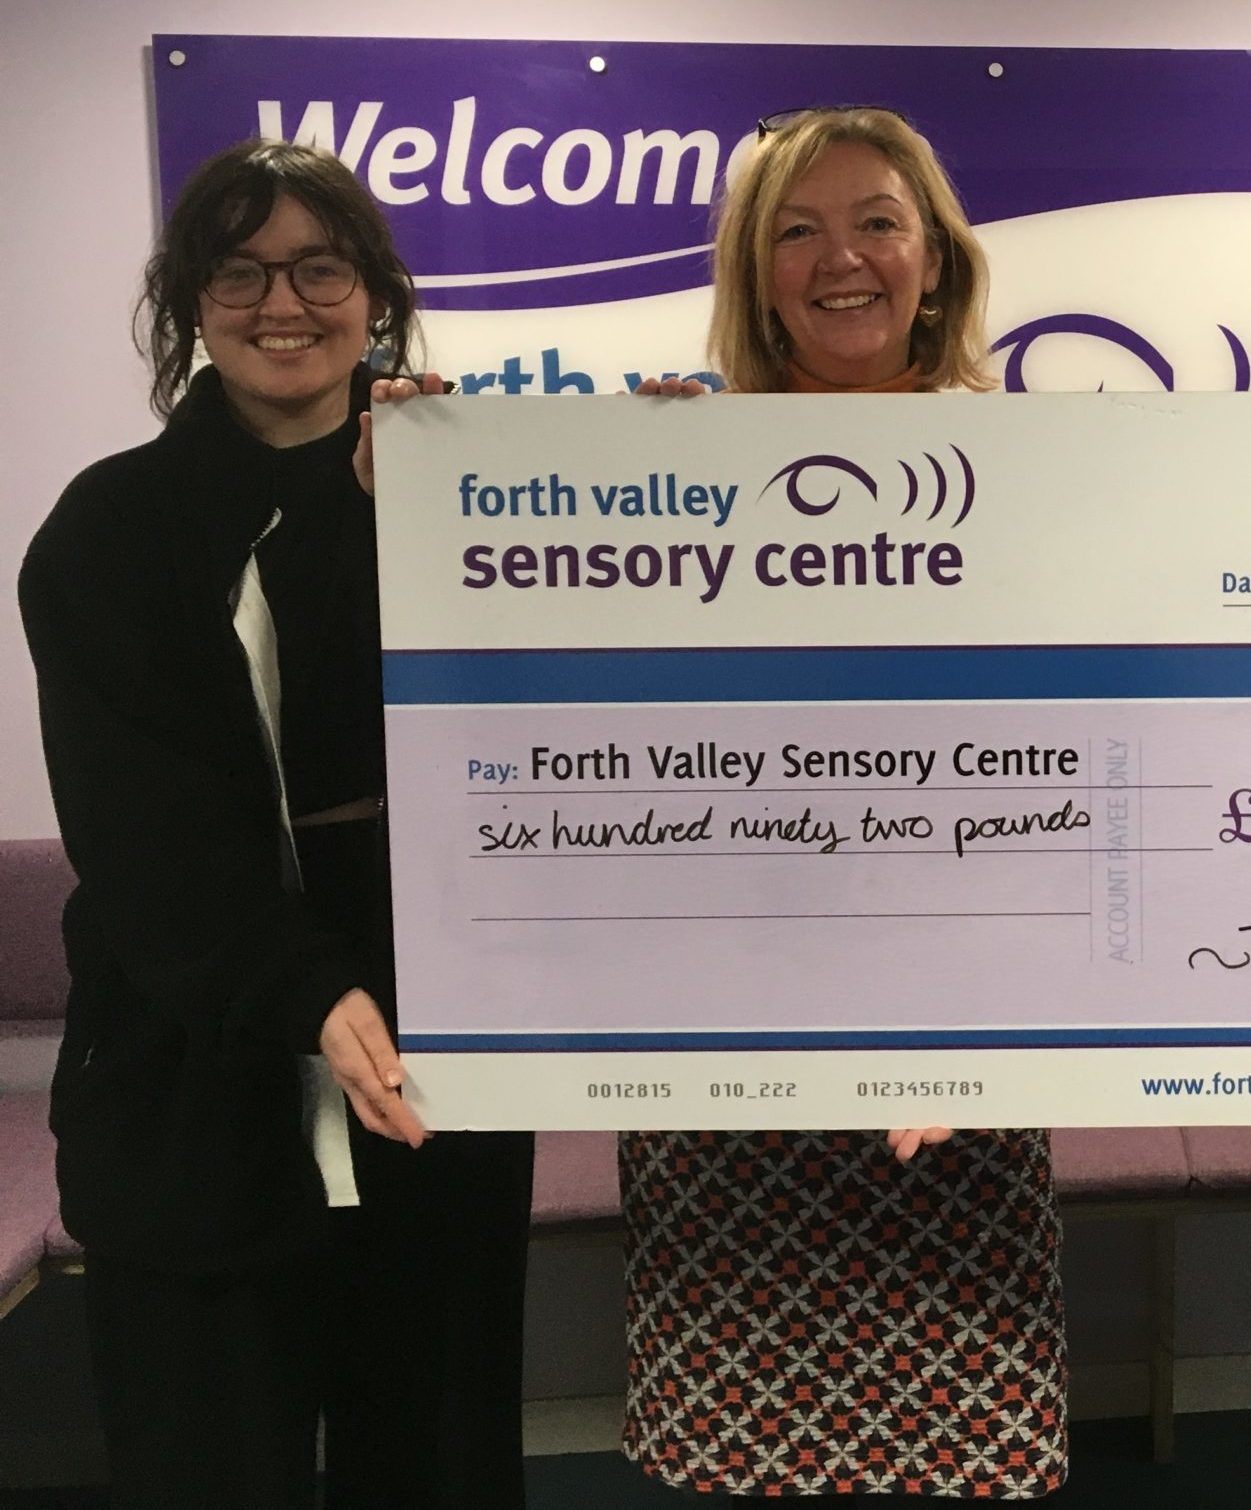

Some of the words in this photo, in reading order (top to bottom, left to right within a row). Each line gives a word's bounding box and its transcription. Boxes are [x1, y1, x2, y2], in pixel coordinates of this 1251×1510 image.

[458, 474, 577, 517] forth
[590, 473, 739, 528] valley
[462, 543, 735, 604] sensory
[754, 531, 963, 587] centre
[468, 759, 519, 785] Pay:
[531, 743, 630, 780] Forth
[647, 742, 766, 787] Valley
[782, 744, 936, 785] Sensory
[952, 742, 1079, 777] Centre
[1106, 738, 1128, 790] ONLY
[478, 804, 541, 851] six
[552, 806, 713, 850] hundred
[730, 807, 851, 854] ninety
[861, 807, 934, 843] two
[955, 800, 1092, 858] pounds
[1107, 797, 1128, 860] PAYEE
[1108, 867, 1129, 963] ACCOUNT
[587, 1083, 671, 1098] 0012815
[709, 1083, 797, 1099] 010_222
[856, 1081, 983, 1097] 0123456789
